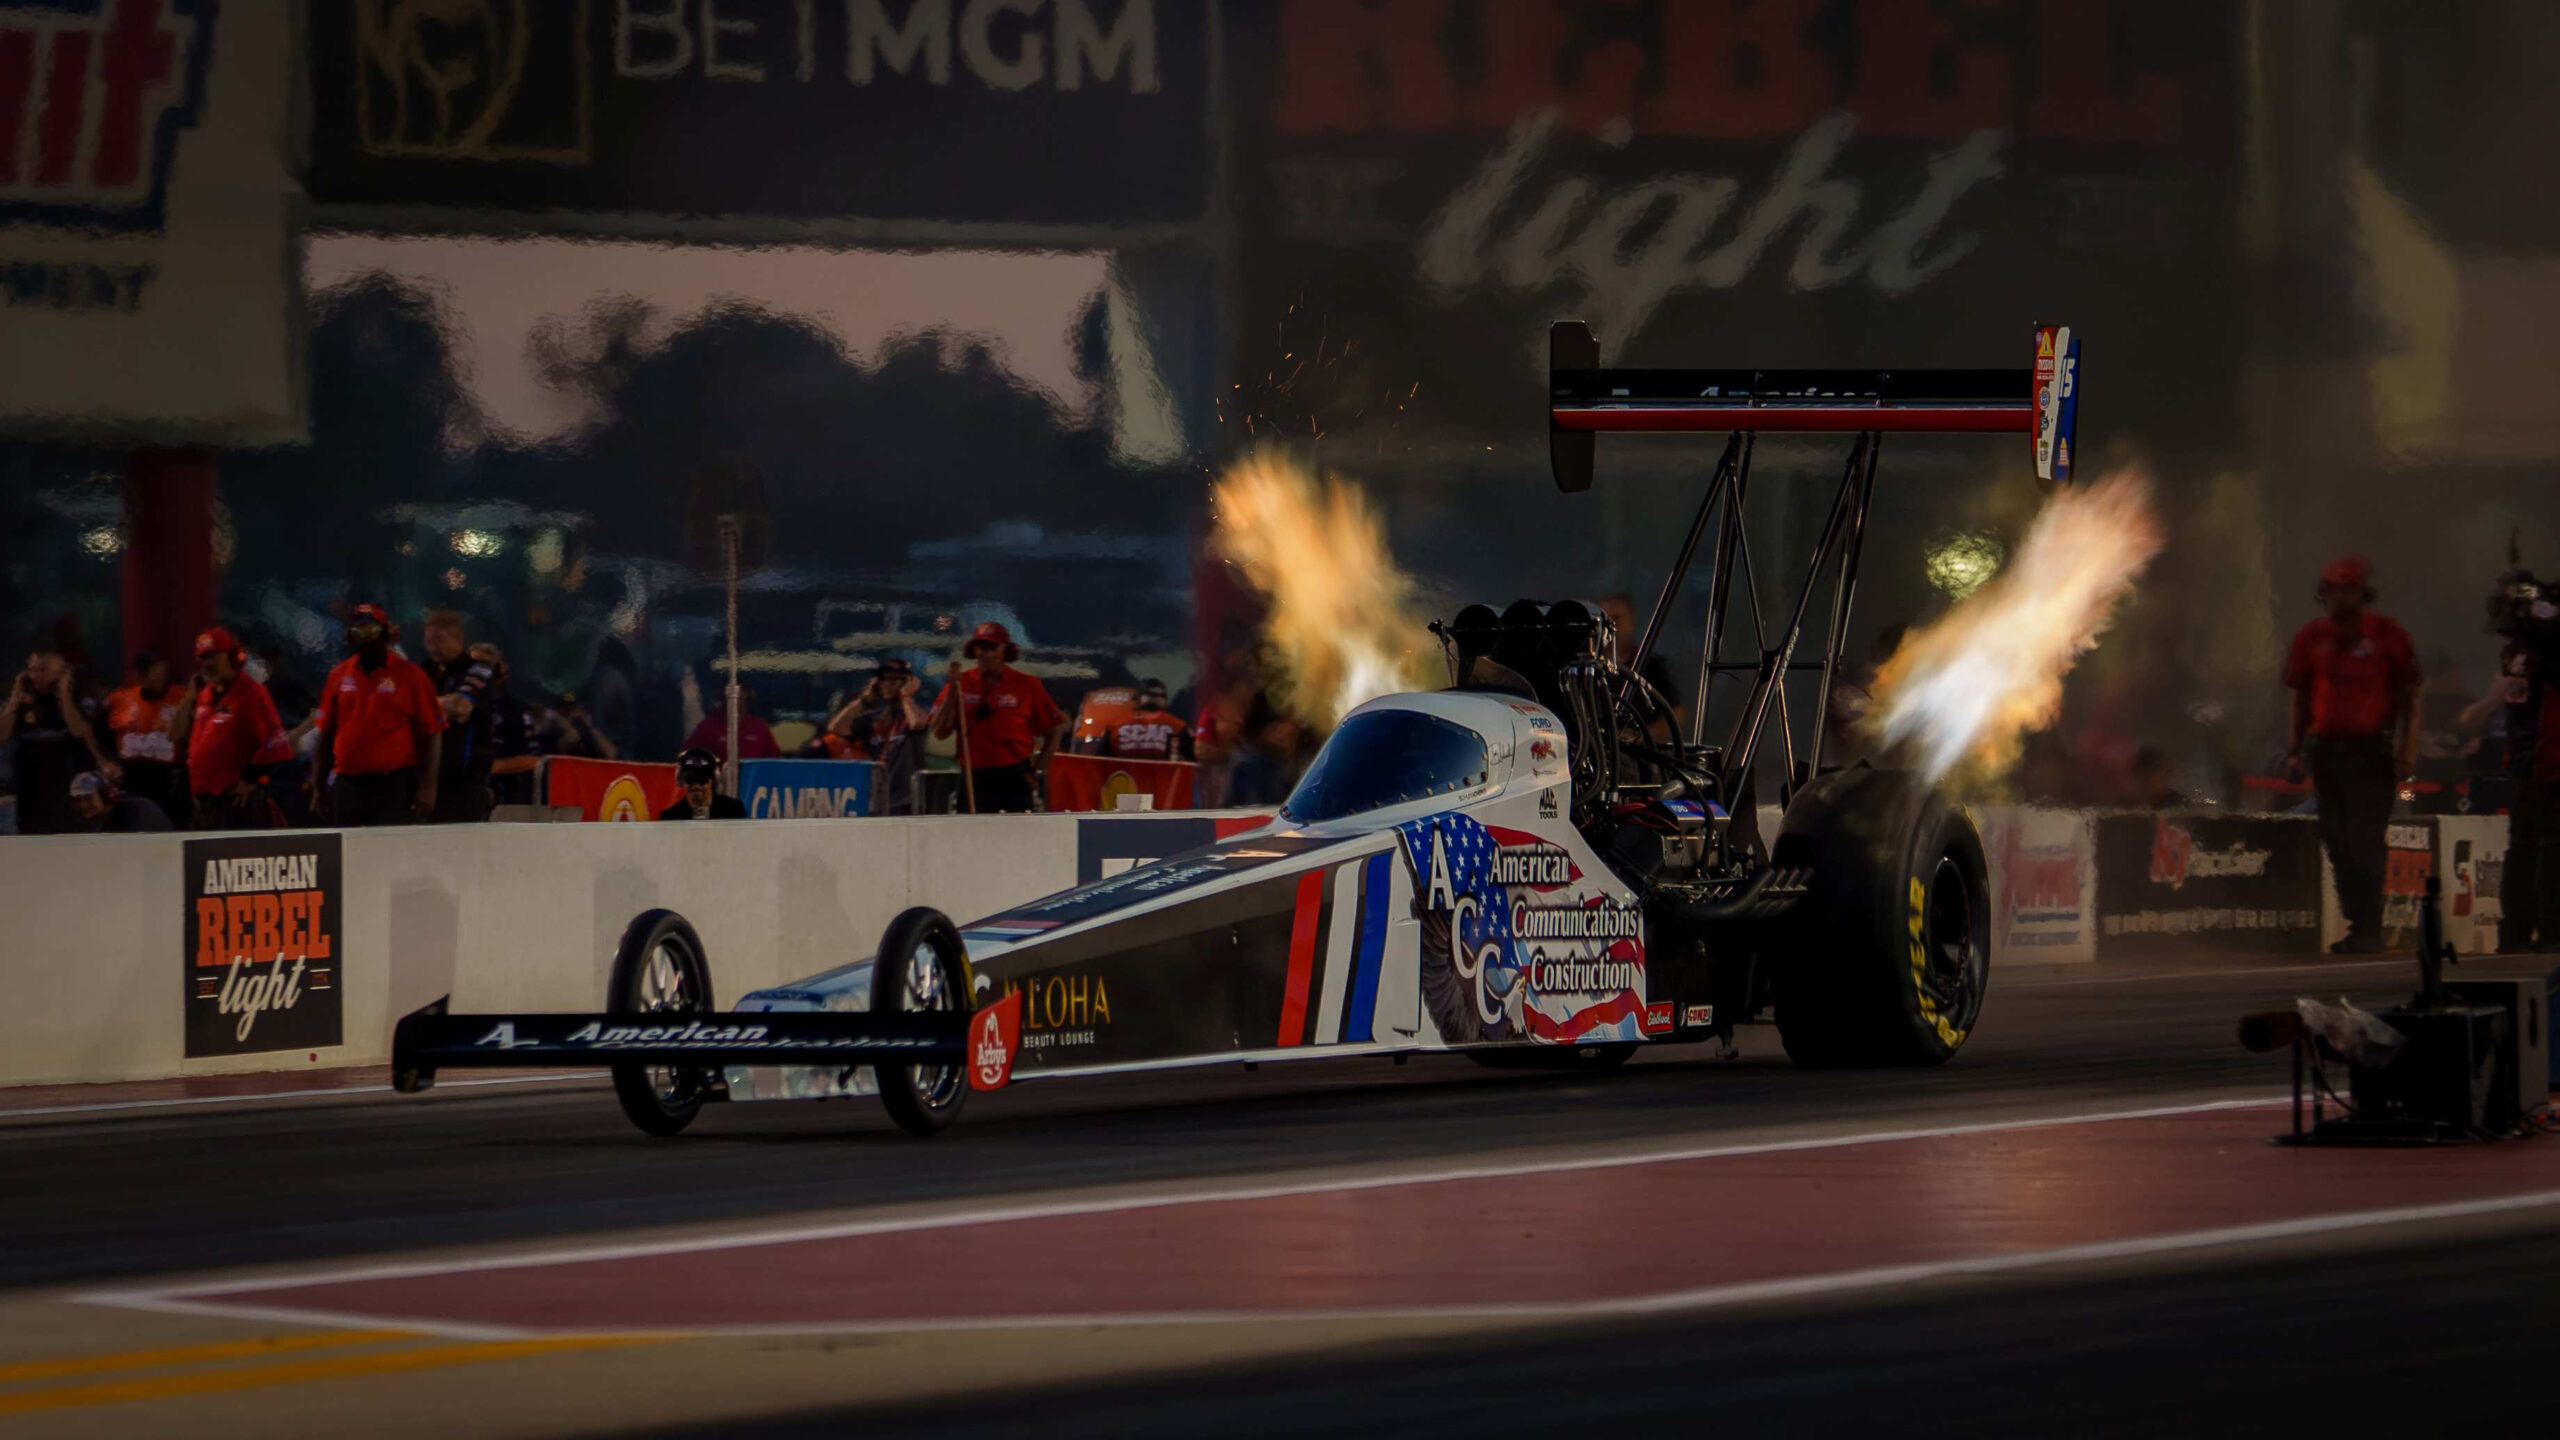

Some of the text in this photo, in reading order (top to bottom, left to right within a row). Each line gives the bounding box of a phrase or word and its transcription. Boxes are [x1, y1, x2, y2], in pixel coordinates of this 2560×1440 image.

[1414, 104, 2010, 375] light
[1530, 718, 1552, 729] FORD
[1539, 787, 1558, 810] MAC
[1539, 811, 1558, 820] TOOLS
[204, 854, 318, 894] AMERICAN
[1489, 844, 1570, 884] American
[196, 890, 331, 967] REBEL
[1511, 897, 1638, 938] Communications
[1531, 952, 1631, 992] Construction
[218, 952, 306, 1042] light
[1012, 972, 1112, 1029] LOHA
[566, 1021, 770, 1041] American
[1024, 1031, 1095, 1048] BEAUTY LOUNGE
